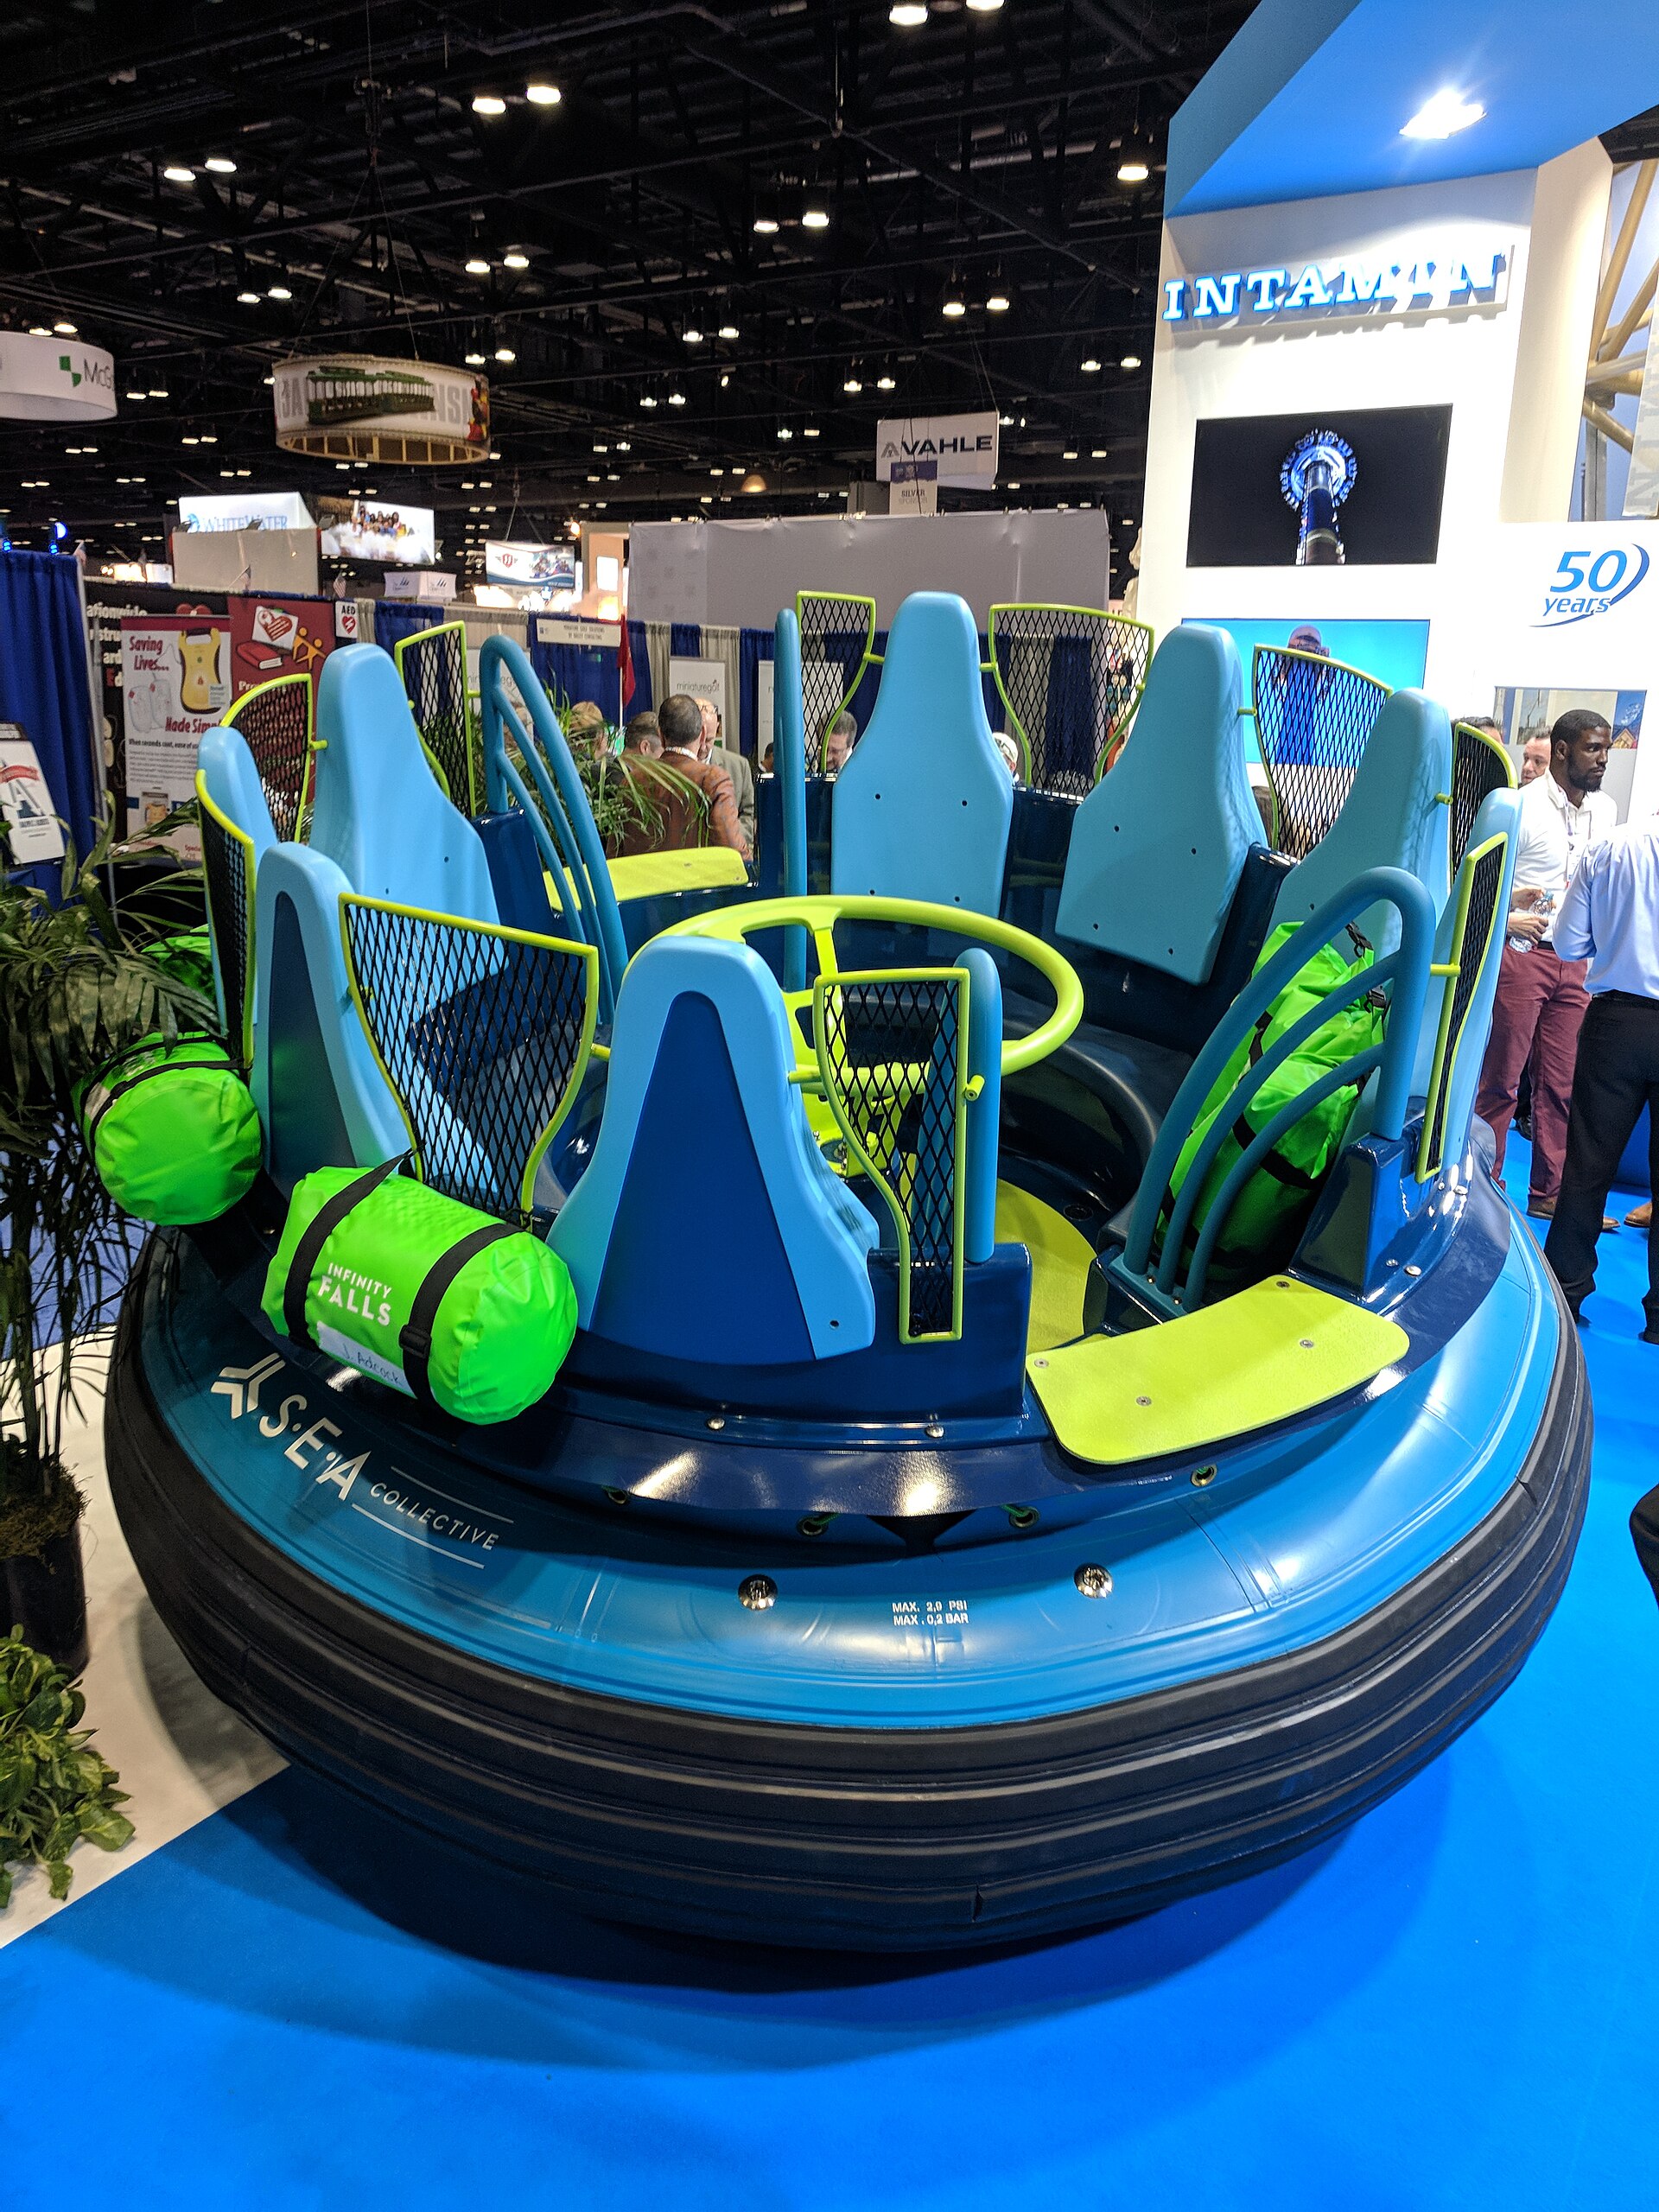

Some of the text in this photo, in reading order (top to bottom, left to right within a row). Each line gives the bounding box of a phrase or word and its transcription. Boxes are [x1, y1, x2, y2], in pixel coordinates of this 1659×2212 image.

[1162, 253, 1504, 321] INTAMIN
[901, 489, 925, 498] SILVR
[1550, 550, 1628, 593] 50
[341, 605, 356, 614] AED
[1542, 598, 1610, 617] years
[129, 635, 163, 655] Saving
[165, 716, 190, 733] Made
[327, 1262, 392, 1299] INFINITY
[317, 1275, 391, 1326] FALLS
[370, 1483, 499, 1551] COLLECTIVE
[949, 1599, 968, 1611] PSI
[945, 1612, 969, 1624] BAR
